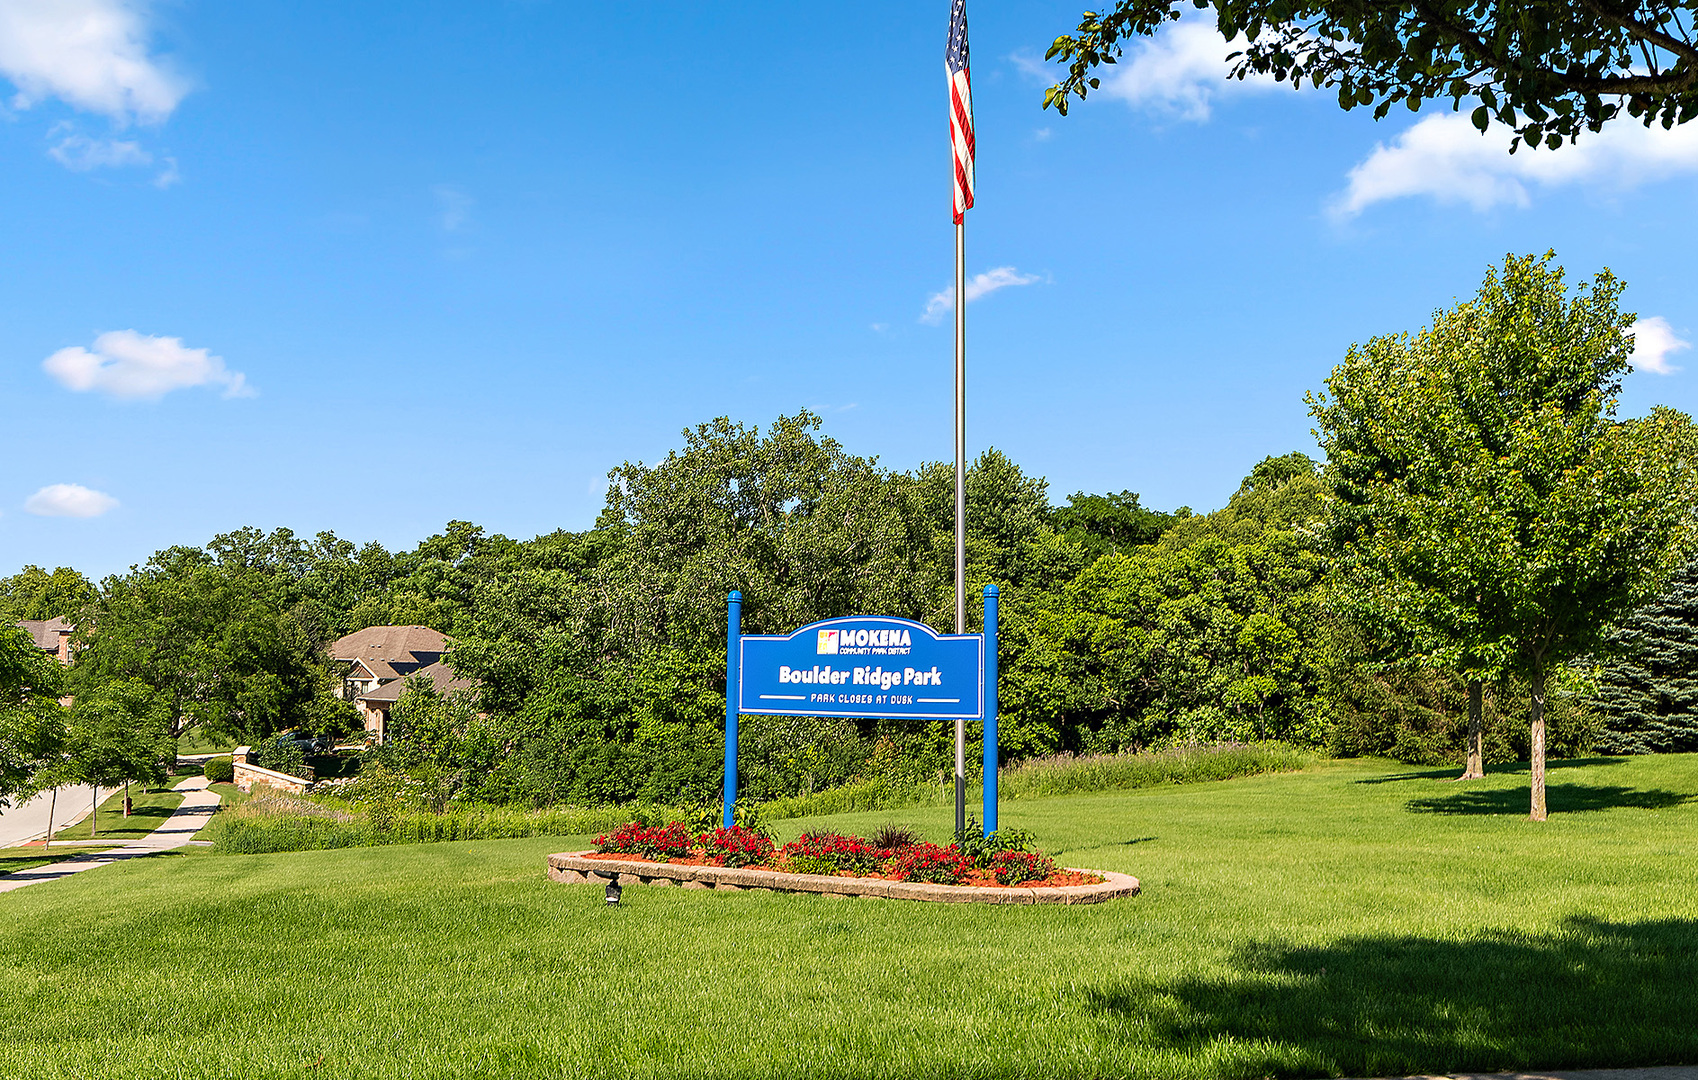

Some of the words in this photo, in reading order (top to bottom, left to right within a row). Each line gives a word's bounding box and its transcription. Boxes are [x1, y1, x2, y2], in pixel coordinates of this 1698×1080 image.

[839, 629, 912, 646] MOKENA
[839, 647, 871, 655] COMMUNITY
[872, 647, 888, 655] PARK
[888, 647, 911, 655] DISTRICT
[779, 665, 850, 685] Boulder
[853, 666, 901, 690] Ridge
[904, 666, 942, 686] Park
[810, 693, 835, 703] PARK
[838, 694, 873, 704] CLOSES
[875, 695, 887, 704] AT
[890, 695, 913, 705] DUSK
